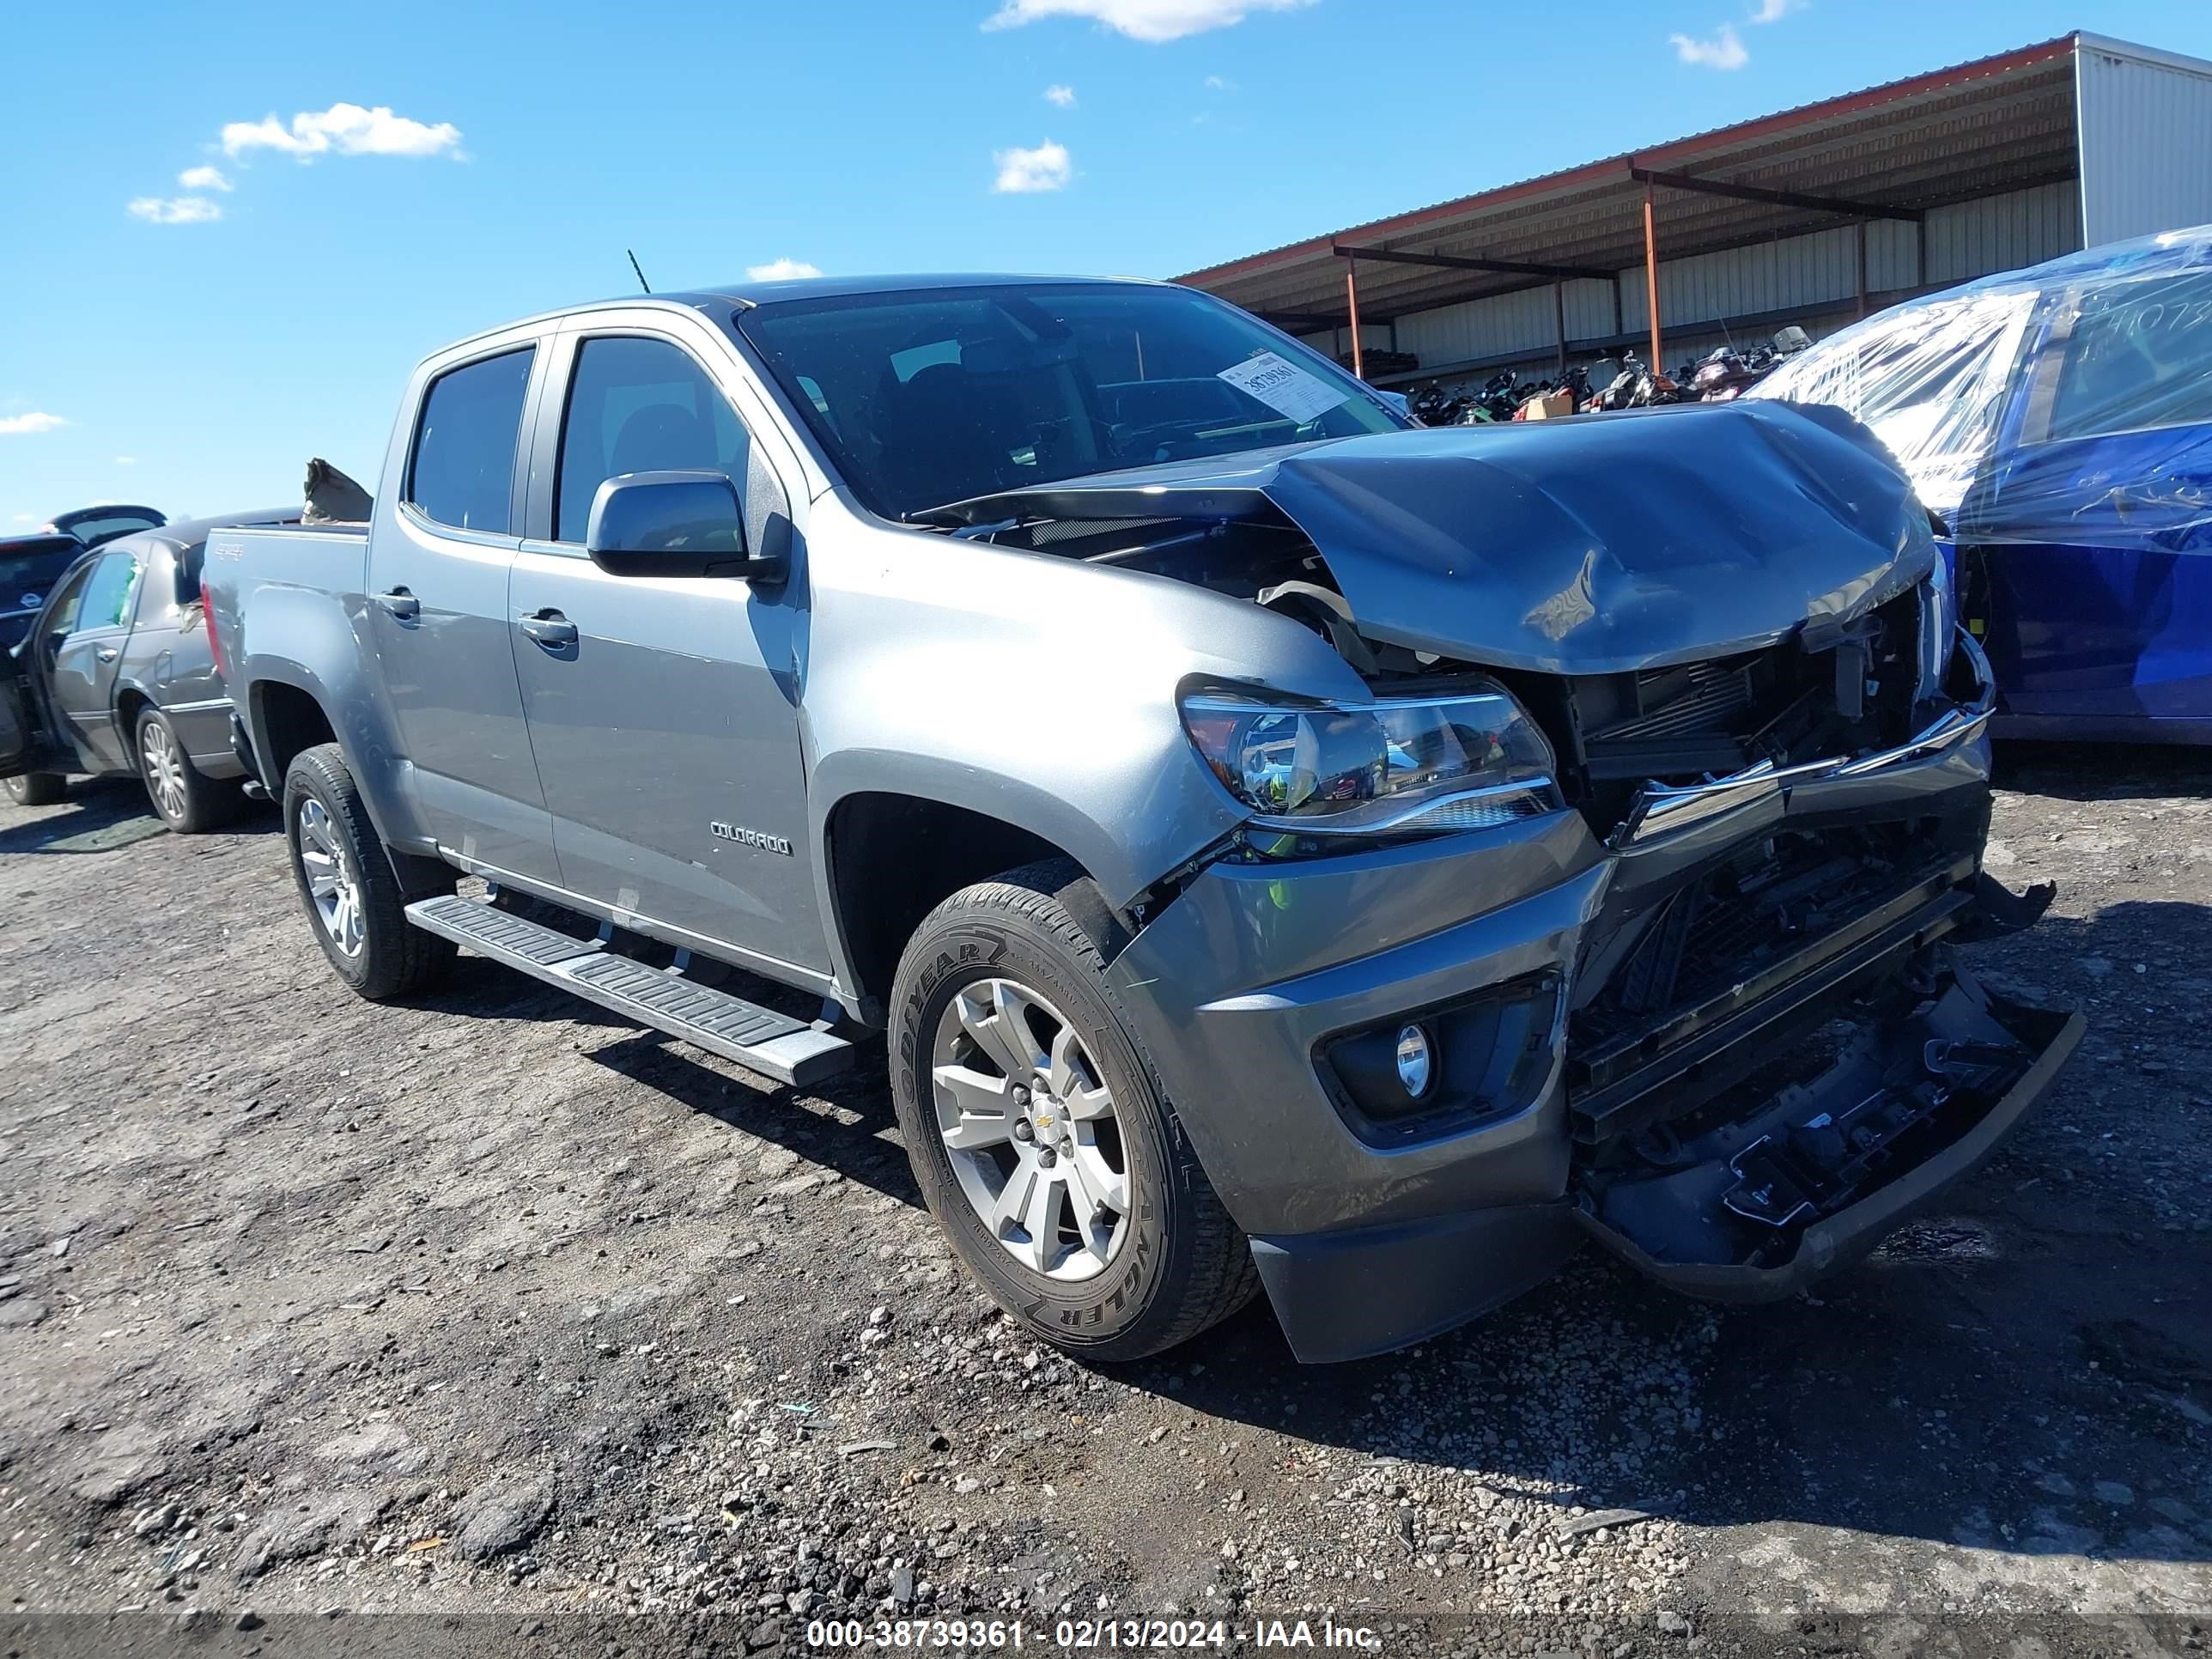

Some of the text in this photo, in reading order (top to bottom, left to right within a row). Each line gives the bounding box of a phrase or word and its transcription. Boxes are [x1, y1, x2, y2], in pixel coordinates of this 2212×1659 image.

[1244, 365, 1297, 392] 38739361
[710, 820, 791, 855] COLORADO
[901, 942, 981, 1181] GOODYEAR
